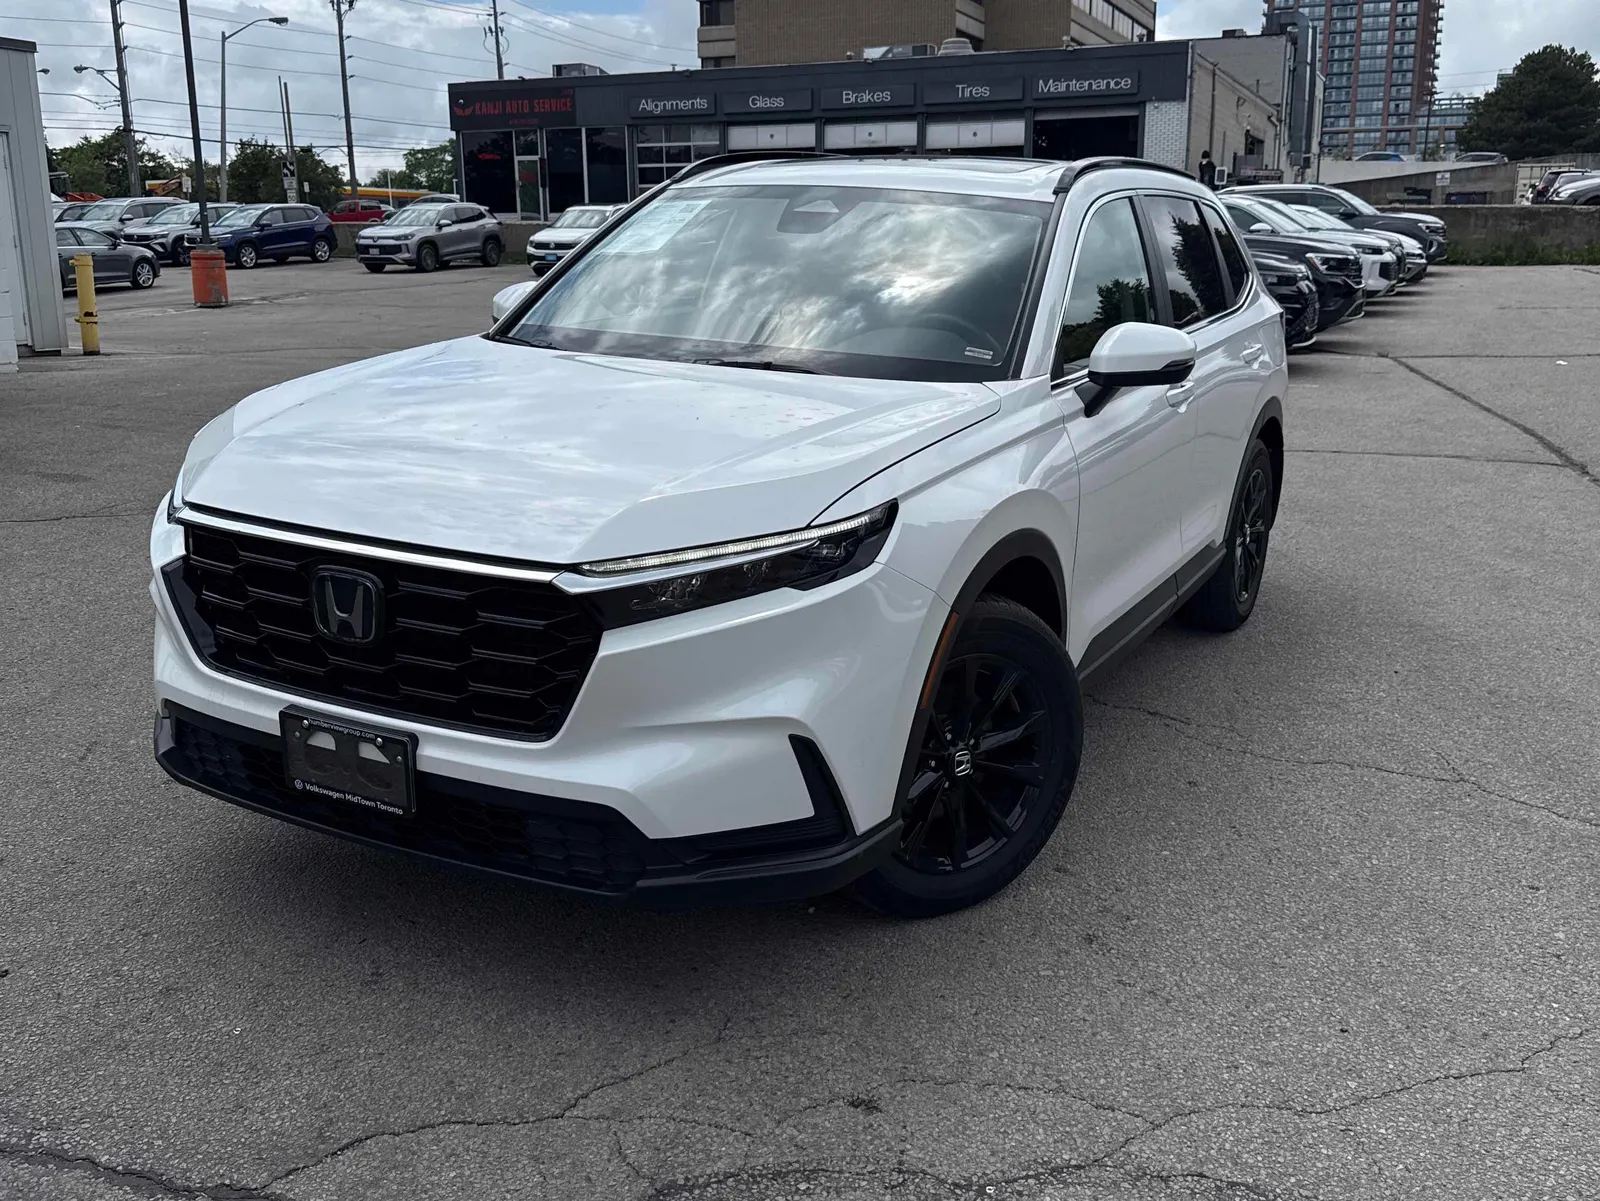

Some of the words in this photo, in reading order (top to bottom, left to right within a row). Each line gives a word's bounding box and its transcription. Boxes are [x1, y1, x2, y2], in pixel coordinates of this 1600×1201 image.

[955, 84, 990, 98] Tires
[1038, 76, 1131, 94] Maintenance
[748, 95, 785, 109] Glass
[842, 90, 891, 104] Brakes
[475, 101, 503, 115] KANJI
[505, 100, 530, 114] AUTO
[533, 98, 572, 113] SERVICE
[638, 97, 708, 115] Alignments
[308, 719, 376, 739] humberviewgroup.com
[305, 782, 345, 799] Volkswagen
[345, 793, 376, 808] MidTown
[377, 801, 404, 815] Toronto
